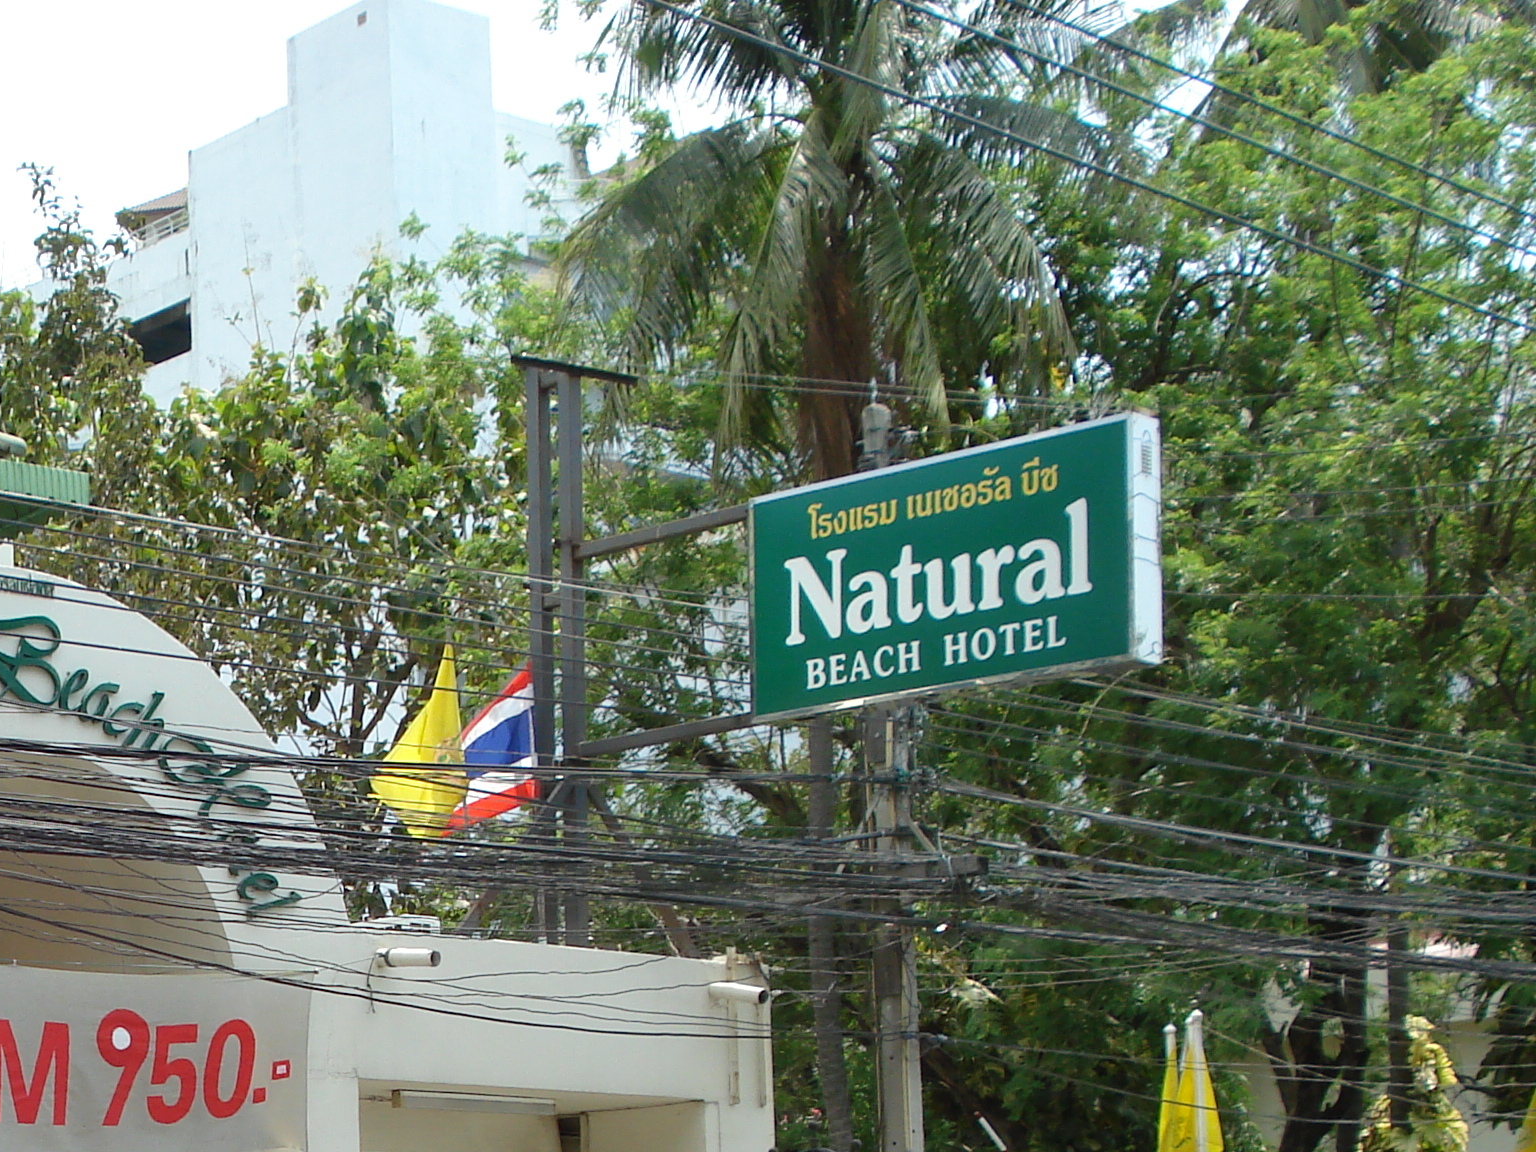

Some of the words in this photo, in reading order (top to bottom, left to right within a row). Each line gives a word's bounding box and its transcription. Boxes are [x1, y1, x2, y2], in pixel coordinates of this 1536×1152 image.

[807, 502, 897, 540] โรงแรม
[906, 466, 1012, 520] เนเชอรัล
[1021, 456, 1059, 497] บีช
[783, 497, 1093, 646] Natural
[805, 640, 921, 690] BEACH
[943, 615, 1067, 667] HOTEL
